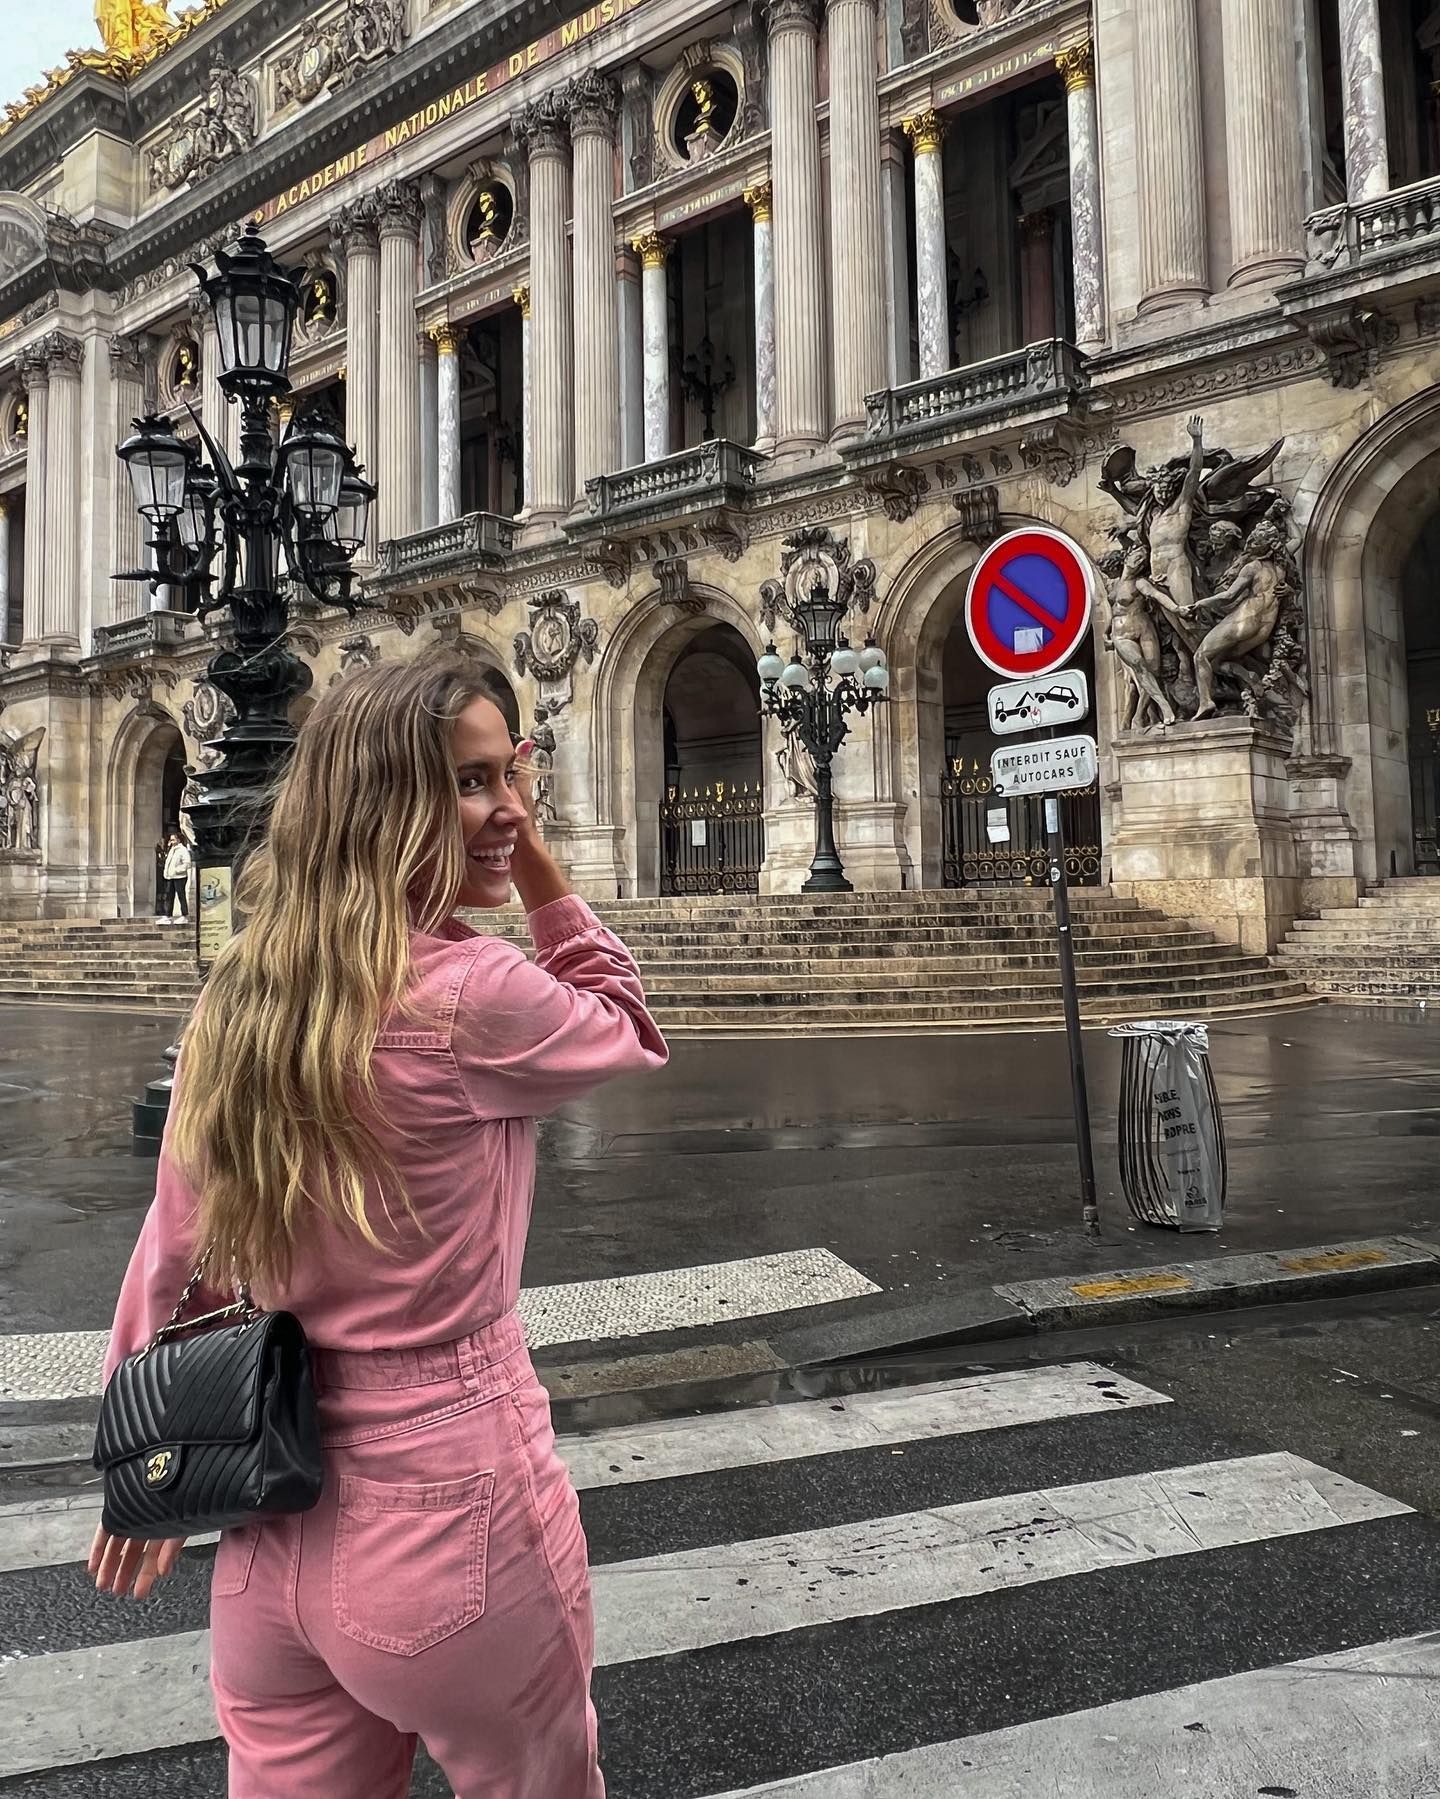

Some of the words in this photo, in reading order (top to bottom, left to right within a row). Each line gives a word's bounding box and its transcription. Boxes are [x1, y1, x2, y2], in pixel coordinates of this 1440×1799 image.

[276, 143, 368, 215] ACADEMIE
[383, 71, 489, 150] NATIONALE
[508, 41, 541, 78] DE
[997, 751, 1050, 769] INTERDIT
[1055, 746, 1086, 760] SAUF
[1013, 766, 1074, 784] AUTOCARS
